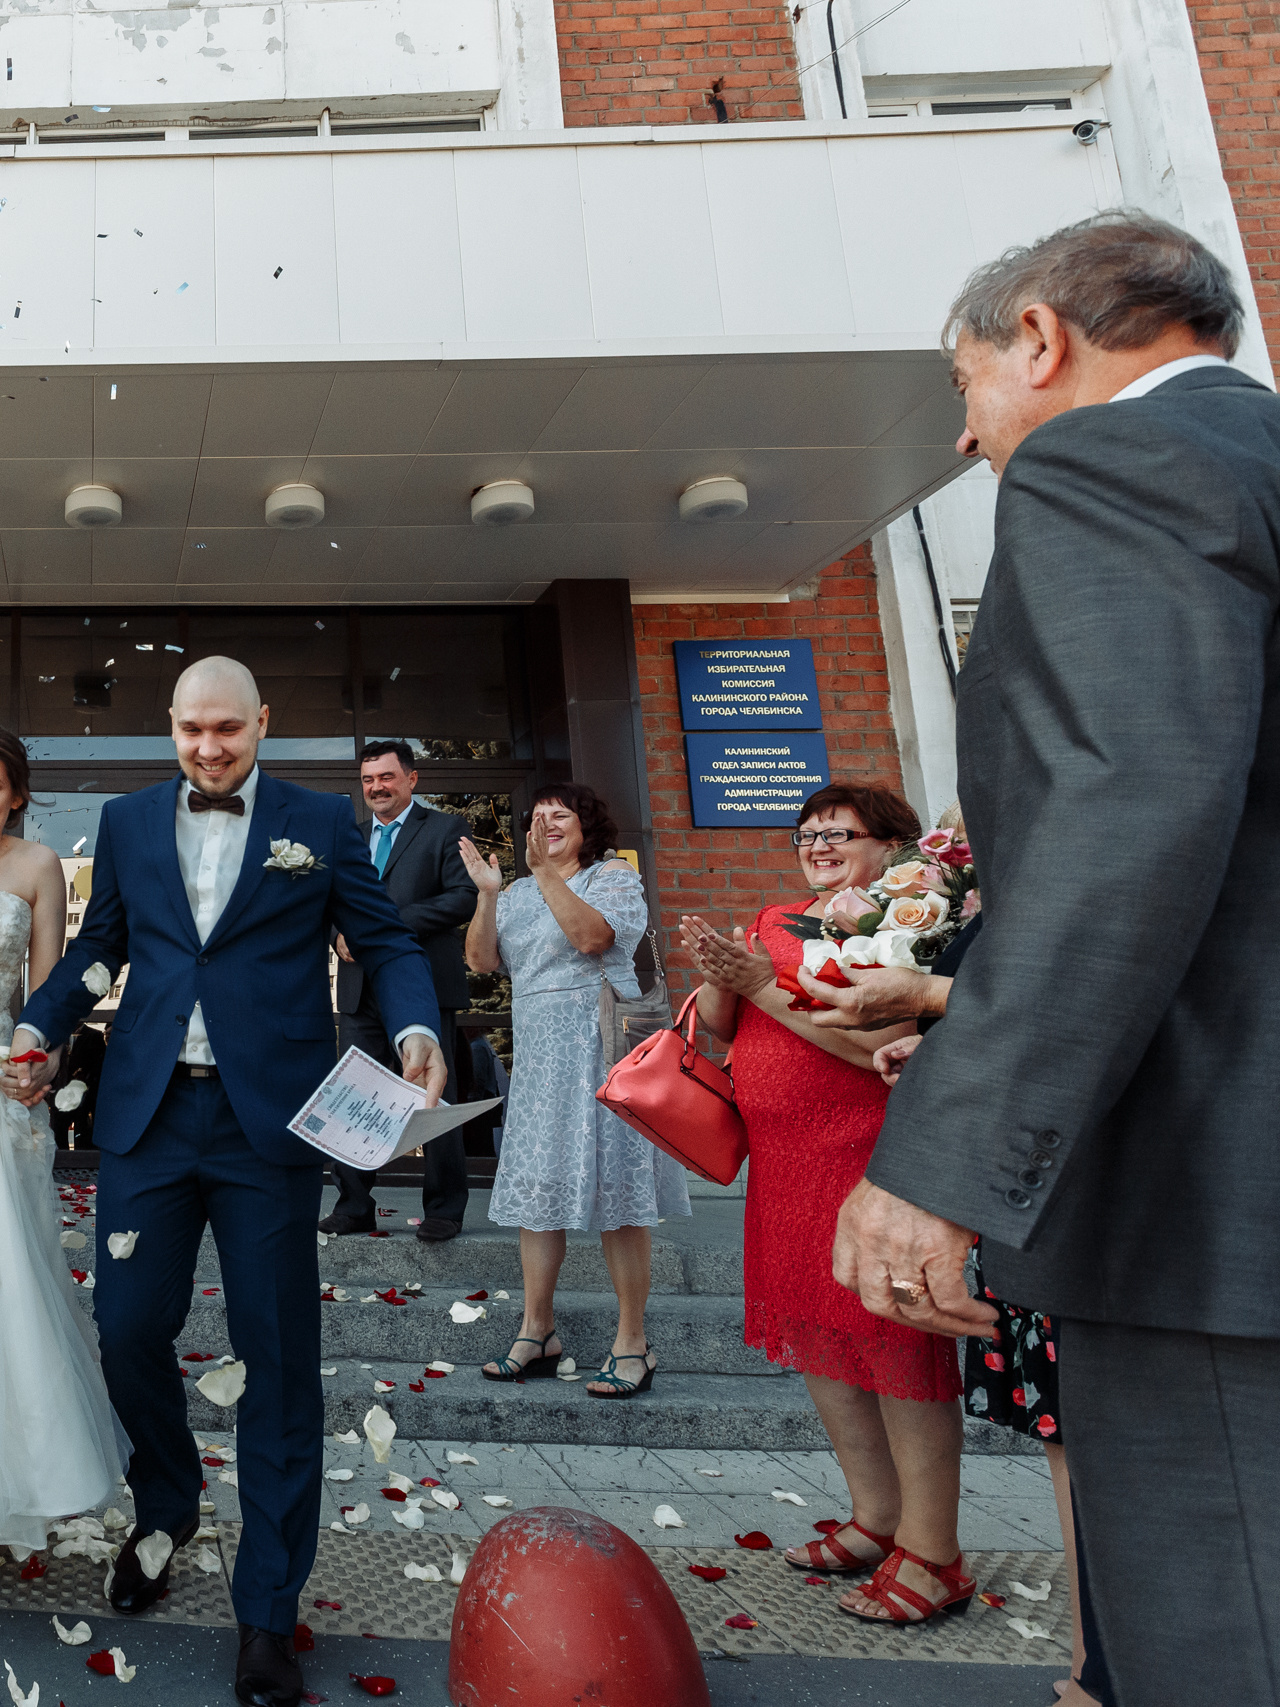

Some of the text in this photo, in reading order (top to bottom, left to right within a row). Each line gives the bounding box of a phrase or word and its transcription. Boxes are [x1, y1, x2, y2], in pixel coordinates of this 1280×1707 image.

[699, 650, 791, 659] ТЕРРИТОРИАЛЬНАЯ
[707, 664, 786, 673] ИЗБИРАТЕЛЬНАЯ
[721, 679, 775, 688] КОМИССИЯ
[691, 692, 809, 702] КАЛИНИНСКОГО РАЙОНА
[701, 706, 803, 716] ГОРОДА ЧЕЛЯБИНСКА
[724, 746, 791, 756] КАЛИНИНСКИЙ
[712, 761, 807, 770] ОТДЕЛ ЗАПИСИ АКТОВ
[699, 775, 822, 784] ГРАЖДАНСКОГО СОСТОЯНИЯ
[724, 789, 803, 798] АДМИНИСТРАЦИИ
[717, 803, 804, 811] ГОРОДА ЧЕЛЯБИНСК
